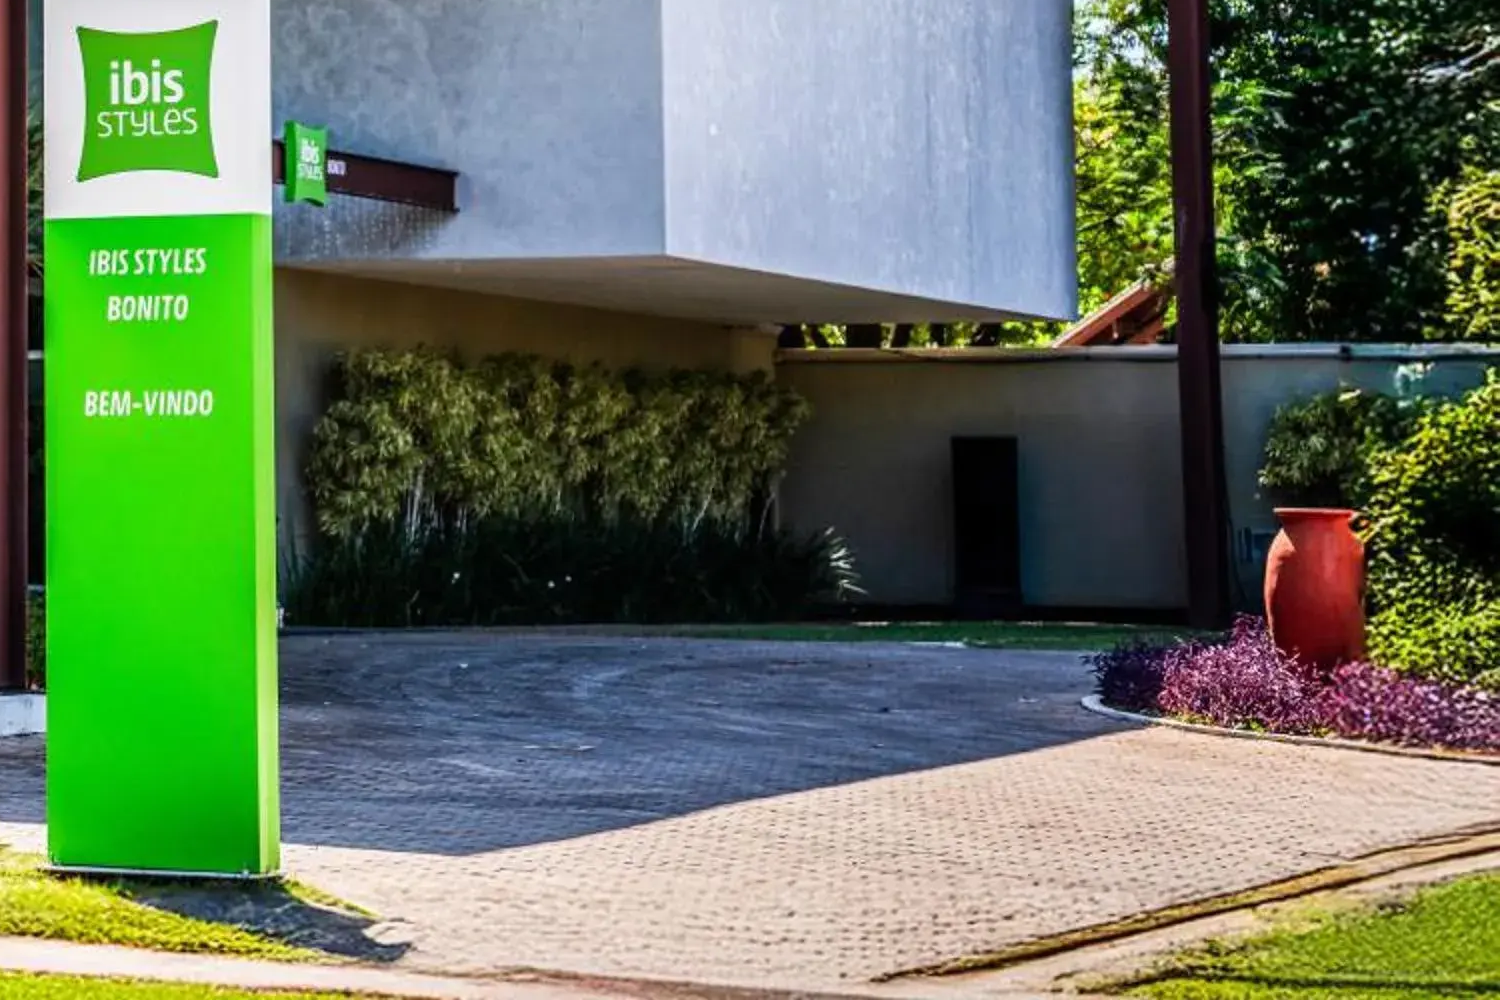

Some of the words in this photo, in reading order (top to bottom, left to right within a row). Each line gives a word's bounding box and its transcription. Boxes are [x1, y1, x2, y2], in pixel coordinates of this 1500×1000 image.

[110, 59, 184, 104] ibis
[89, 249, 129, 276] IBIS
[133, 248, 206, 275] STYLES
[107, 295, 189, 321] BONITO
[85, 390, 213, 417] BEM-VINDO
